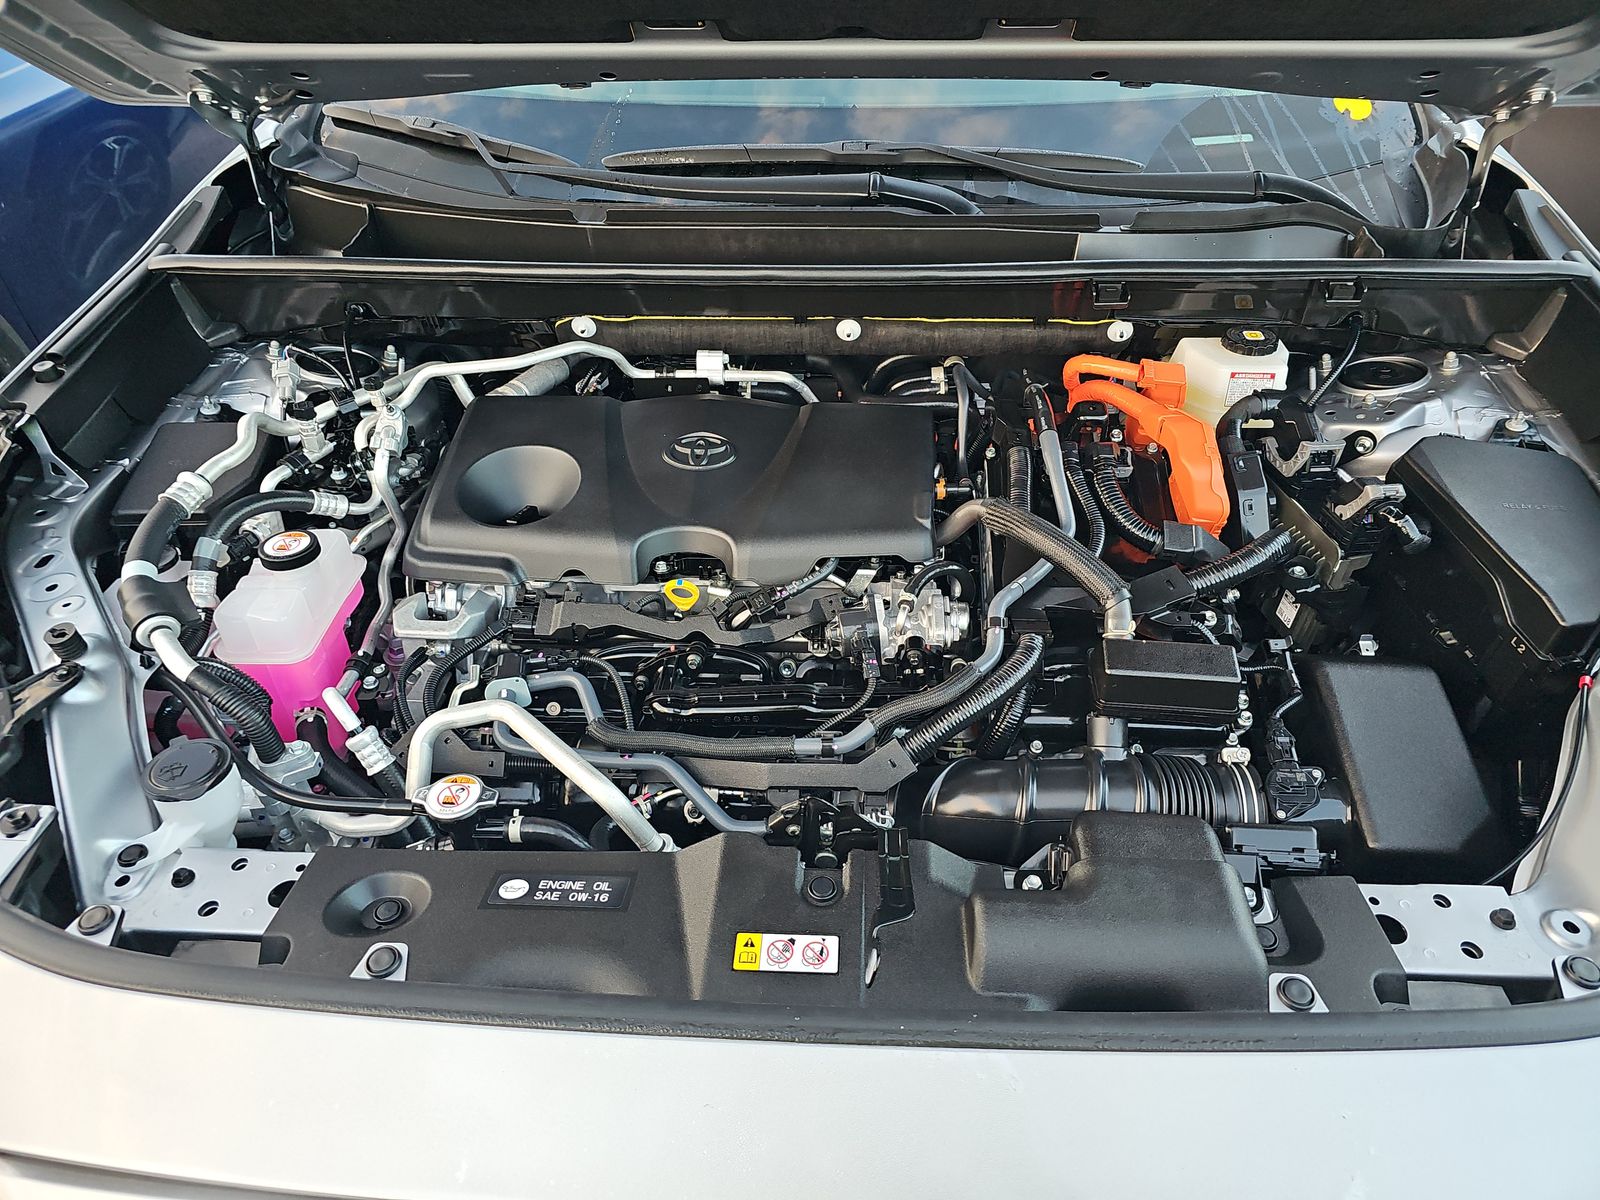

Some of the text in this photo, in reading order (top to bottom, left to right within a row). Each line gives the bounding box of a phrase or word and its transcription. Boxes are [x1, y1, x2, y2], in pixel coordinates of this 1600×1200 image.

[1501, 502, 1532, 510] RELAY
[1510, 636, 1526, 654] L2
[538, 879, 613, 891] ENGINE OIL
[533, 891, 610, 903] SAE 0W-16
